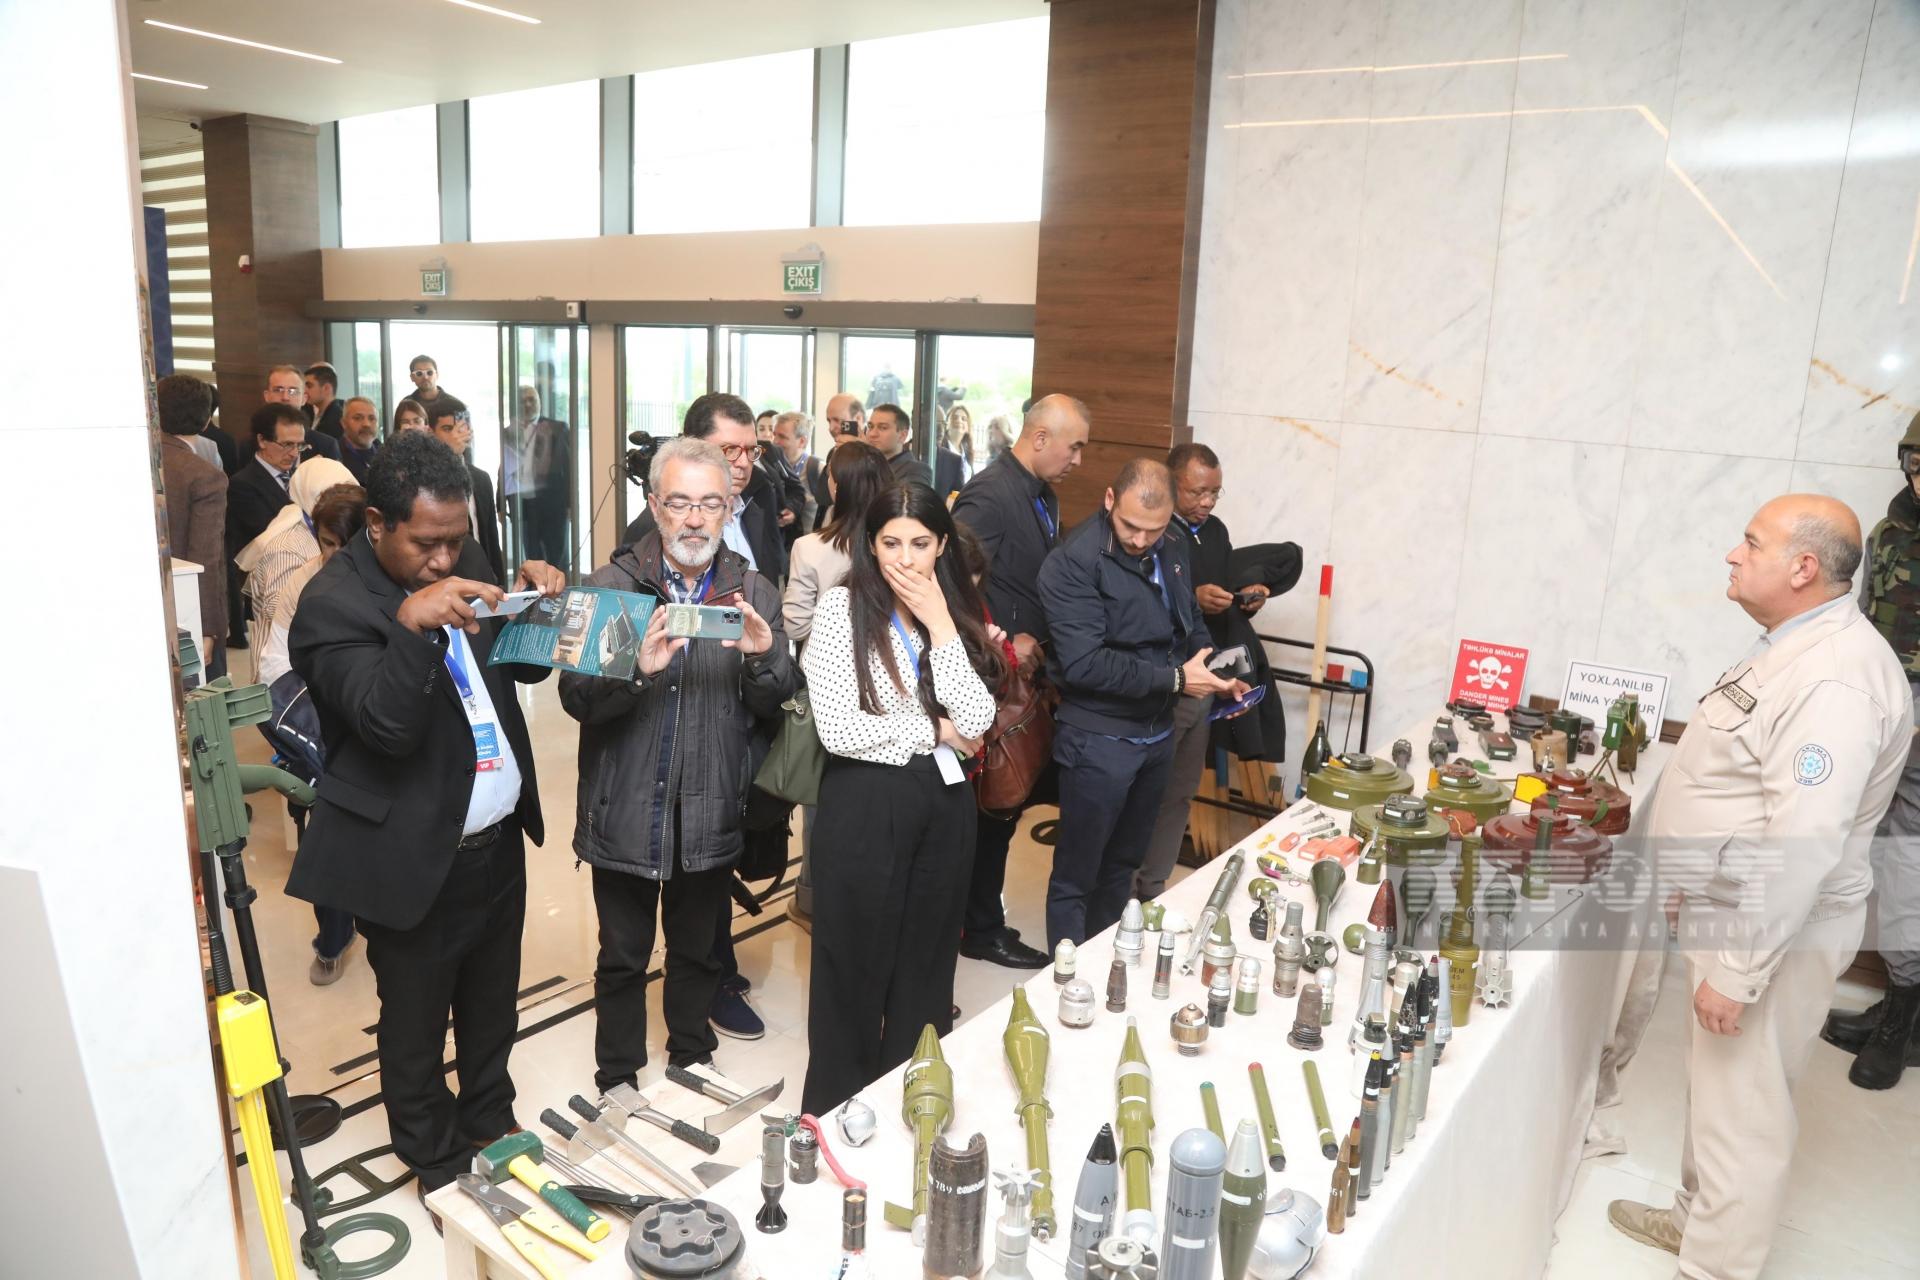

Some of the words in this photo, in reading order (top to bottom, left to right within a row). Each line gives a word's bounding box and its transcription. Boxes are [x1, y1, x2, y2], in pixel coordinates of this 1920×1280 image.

[788, 266, 815, 277] EXIT
[1580, 672, 1653, 692] YOXLANILIB
[1459, 689, 1488, 700] DANGER
[1488, 694, 1509, 704] MINES
[1569, 691, 1599, 705] MİNA
